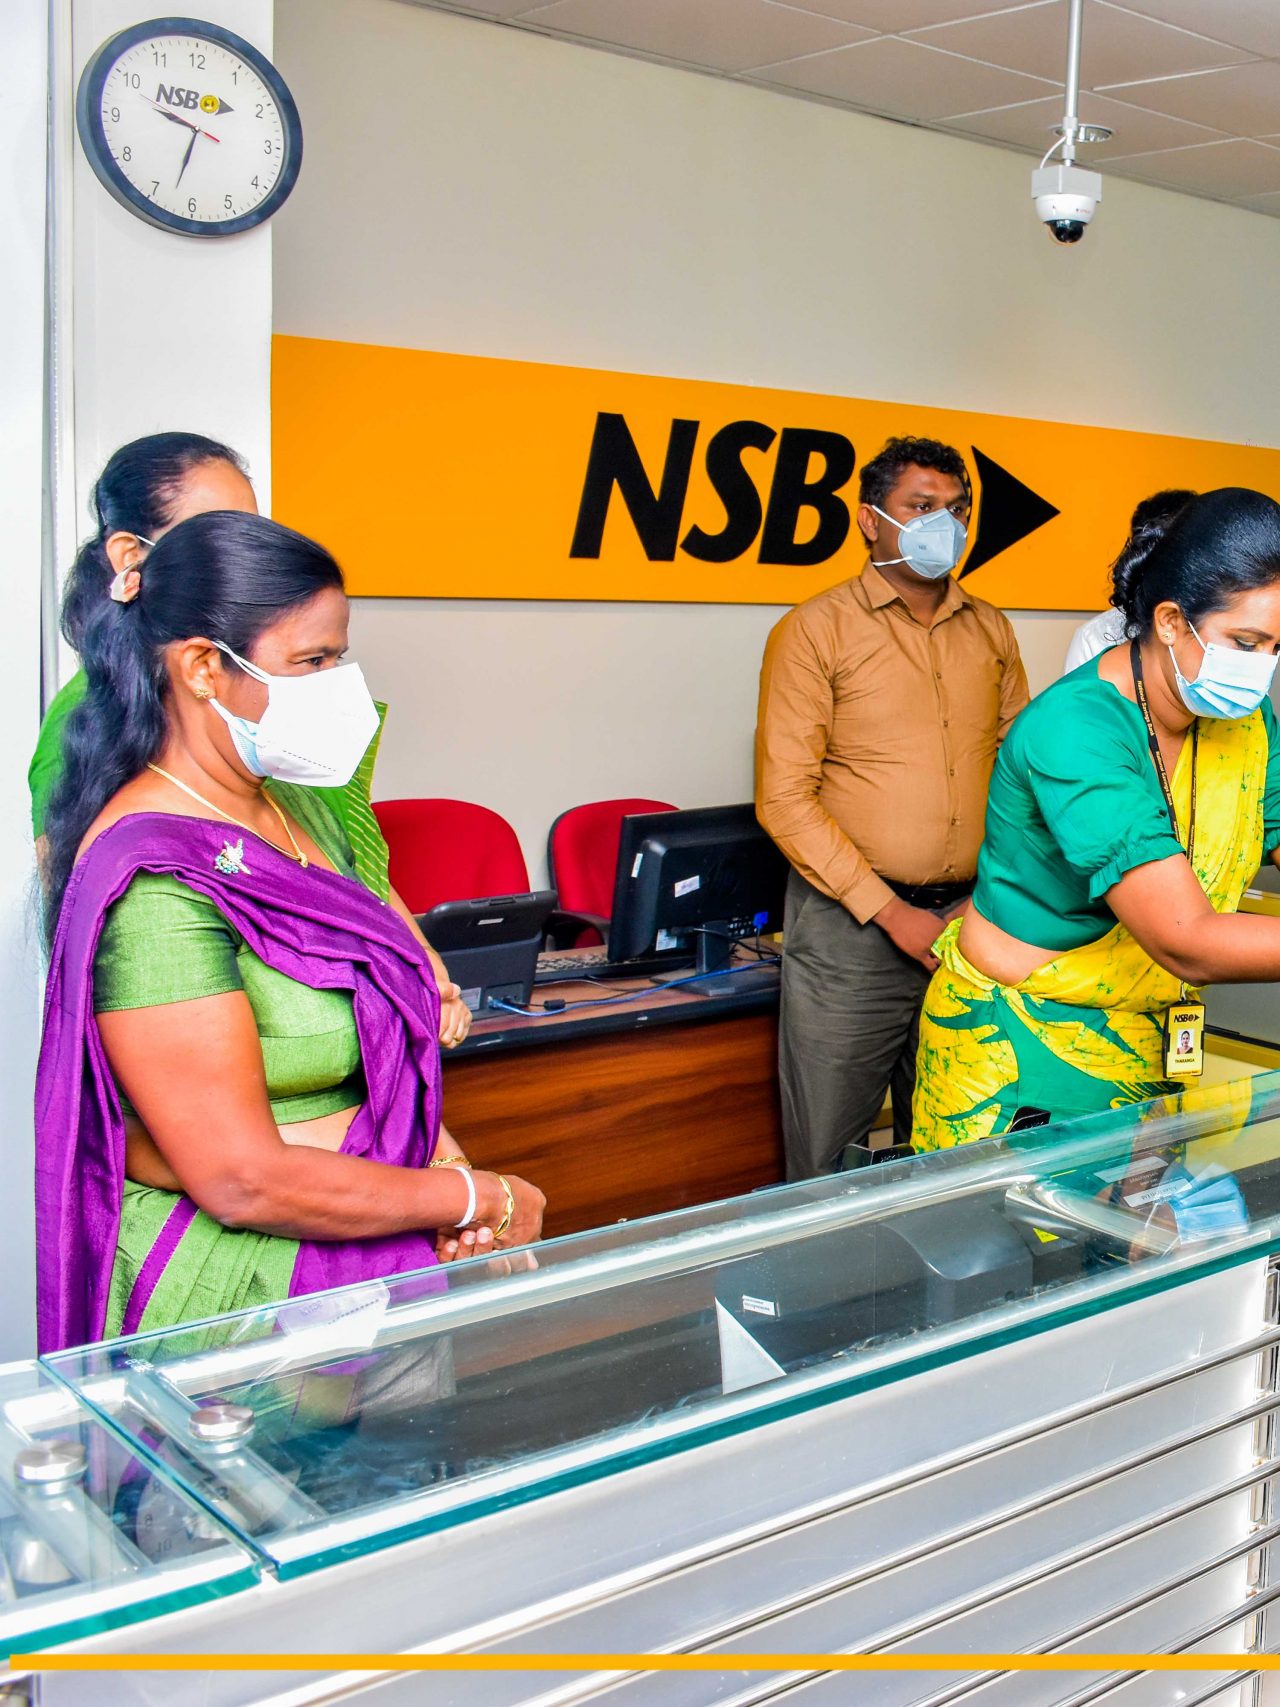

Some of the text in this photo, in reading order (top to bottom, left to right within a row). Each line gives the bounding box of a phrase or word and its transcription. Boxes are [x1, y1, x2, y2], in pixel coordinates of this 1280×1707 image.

[152, 51, 167, 68] 11
[188, 52, 206, 70] 12
[122, 72, 141, 89] 10
[231, 71, 238, 86] 1
[155, 83, 200, 110] NSB
[111, 107, 121, 122] 9
[255, 103, 264, 119] 2
[122, 146, 132, 162] 8
[264, 140, 272, 155] 3
[151, 180, 160, 197] 7
[251, 175, 259, 190] 4
[188, 198, 197, 213] 6
[224, 194, 233, 210] 5
[569, 411, 856, 567] NSB
[1137, 680, 1155, 737] National Savings Bank
[1161, 772, 1170, 793] Savings
[1173, 1013, 1188, 1023] NSB
